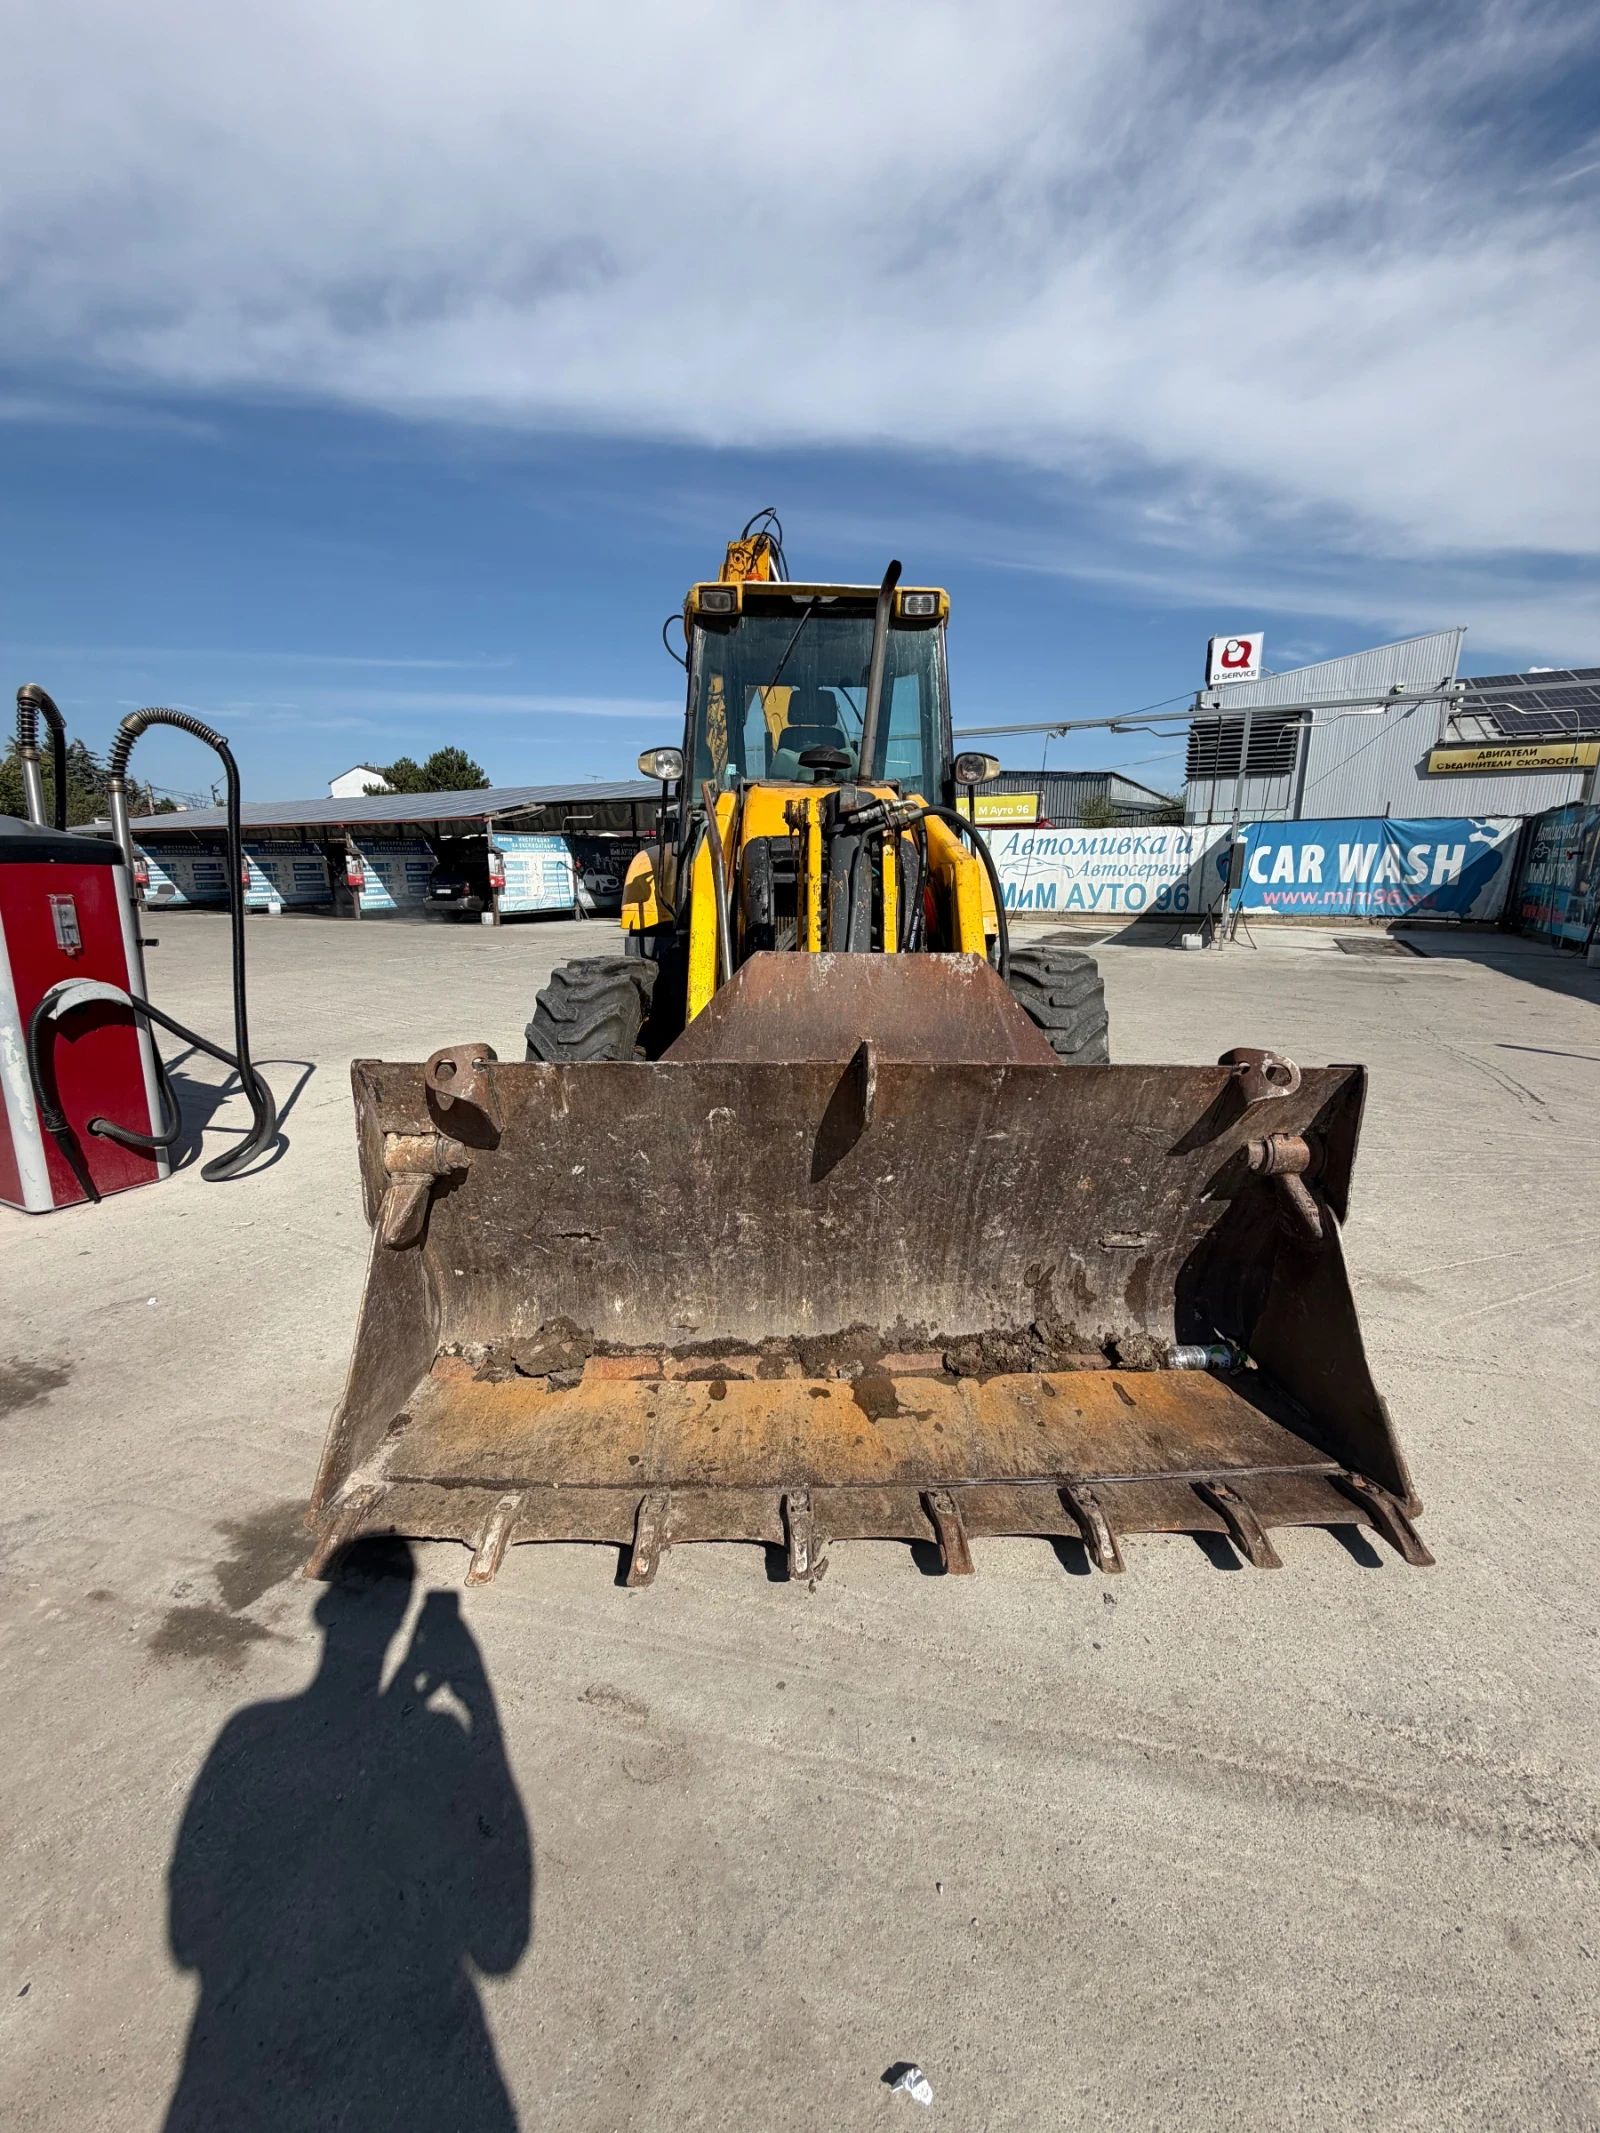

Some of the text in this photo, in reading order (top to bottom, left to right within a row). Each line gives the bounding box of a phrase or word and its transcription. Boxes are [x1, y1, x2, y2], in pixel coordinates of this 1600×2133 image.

[1221, 669, 1257, 680] SERVICE
[1436, 757, 1578, 770] СЪЕДИНИТЕЛИ СКОРОСТИ
[1477, 748, 1538, 760] ДВИГАТЕЛИ
[990, 807, 1013, 816] Ауто
[1016, 805, 1029, 814] 96
[999, 832, 1193, 856] Автомивка и
[1075, 860, 1193, 882] Автосервиз
[1249, 844, 1466, 886] CAR WASH
[1000, 883, 1190, 910] МиМ АУТО 96
[1262, 888, 1437, 908] www.mim96.eu
